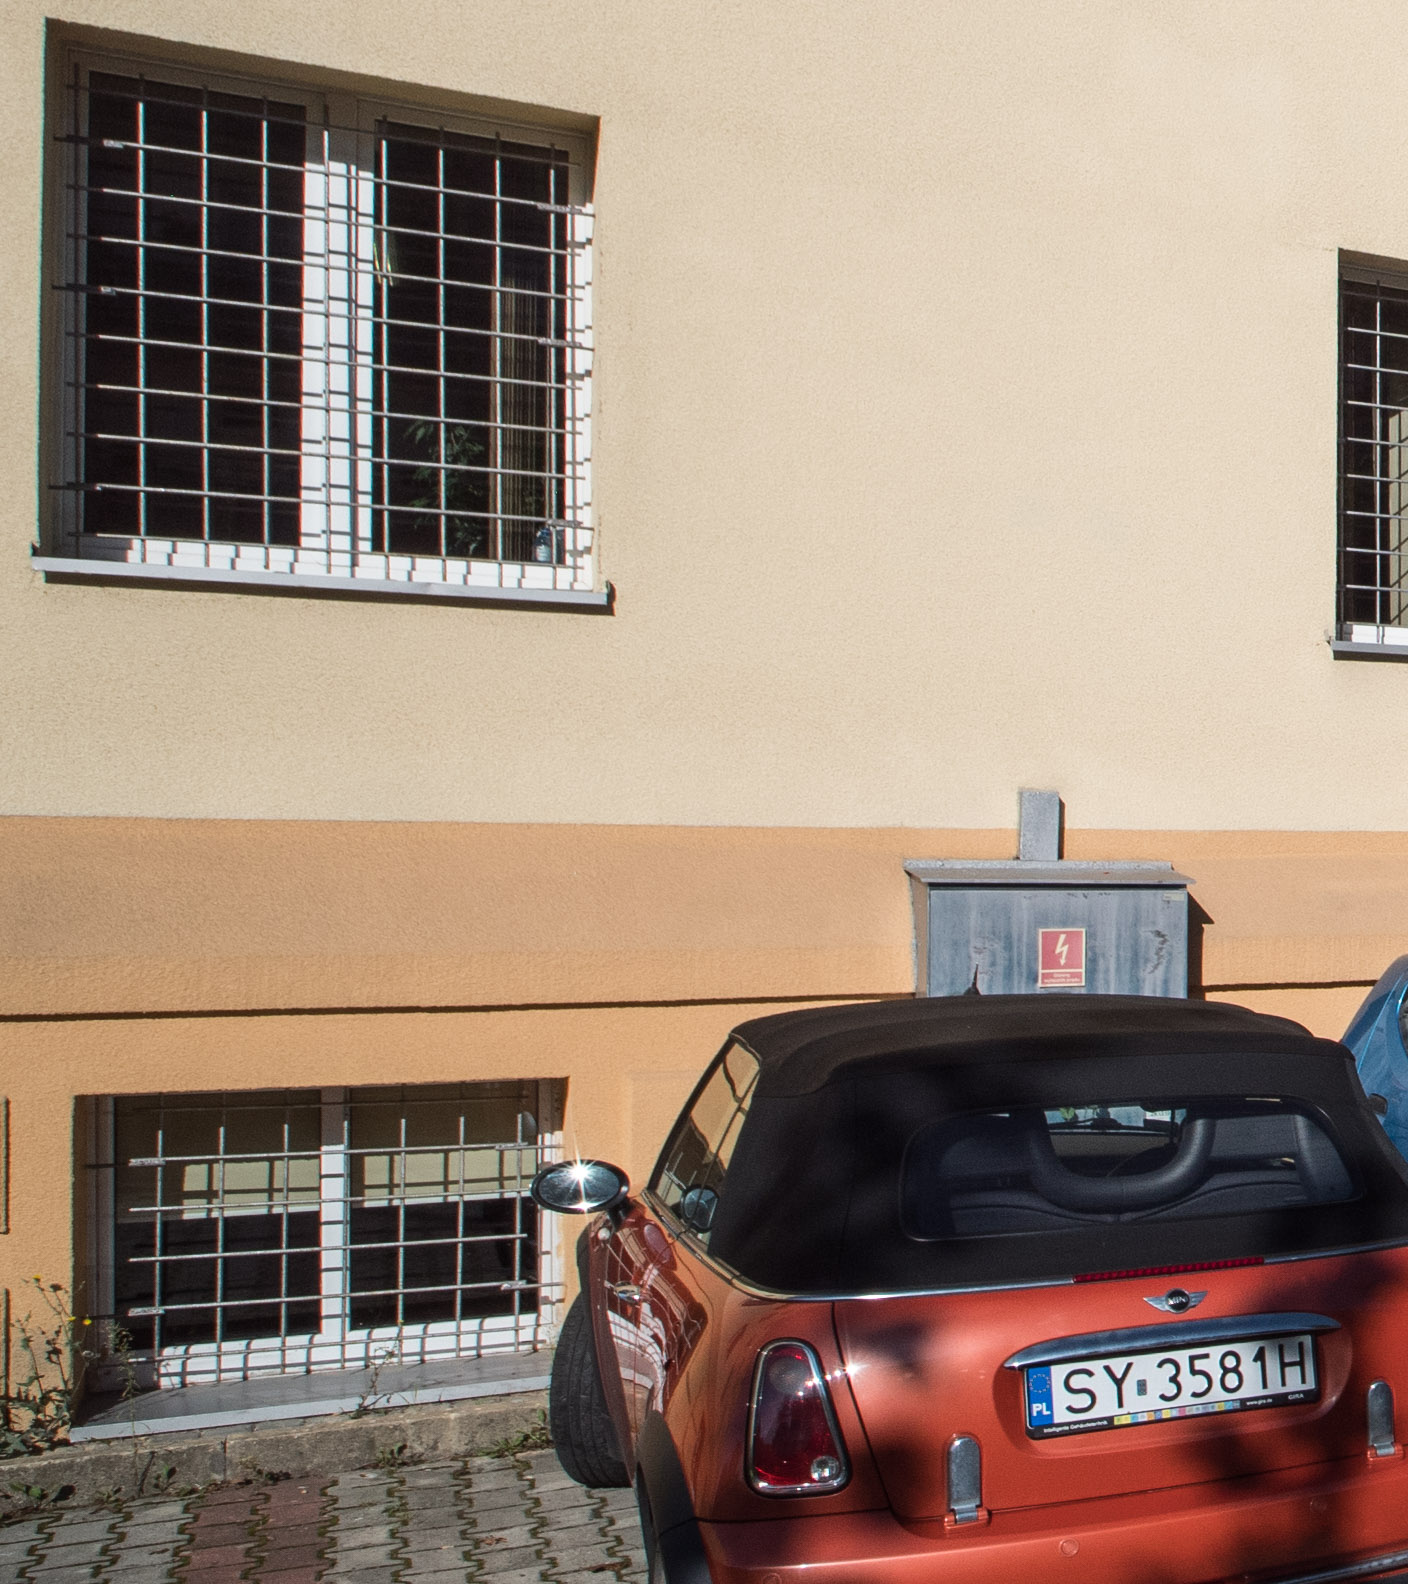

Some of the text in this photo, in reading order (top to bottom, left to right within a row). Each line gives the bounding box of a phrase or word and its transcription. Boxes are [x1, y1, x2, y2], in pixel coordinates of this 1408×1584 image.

[1063, 1341, 1306, 1414] SY 3581H
[1032, 1403, 1052, 1416] PL
